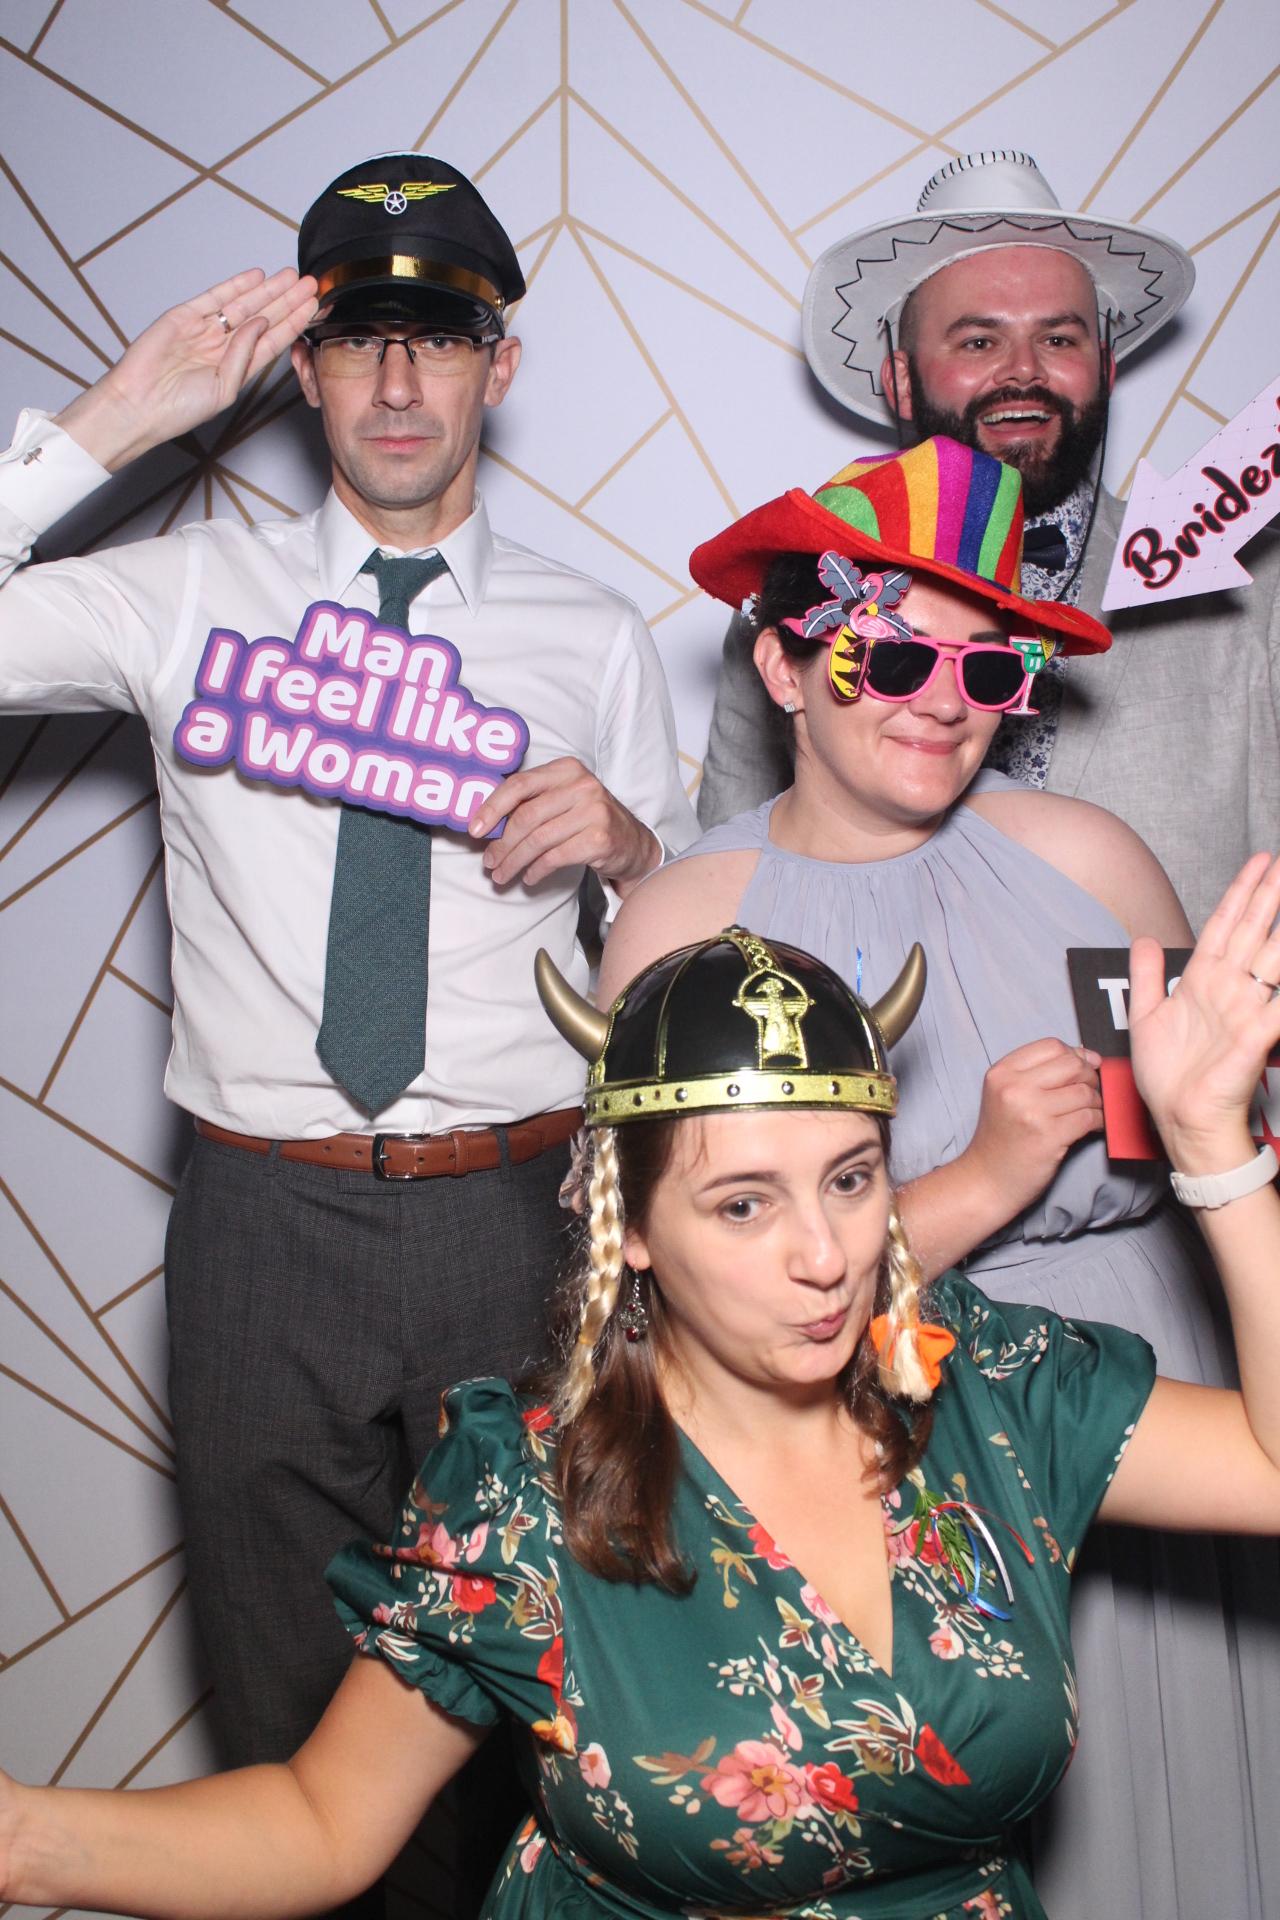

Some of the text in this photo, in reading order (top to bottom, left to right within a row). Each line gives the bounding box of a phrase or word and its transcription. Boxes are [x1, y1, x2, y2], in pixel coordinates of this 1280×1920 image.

[1122, 396, 1280, 590] Bridez
[207, 641, 517, 762] I feel like
[305, 612, 448, 689] Man
[186, 711, 495, 818] a Woman
